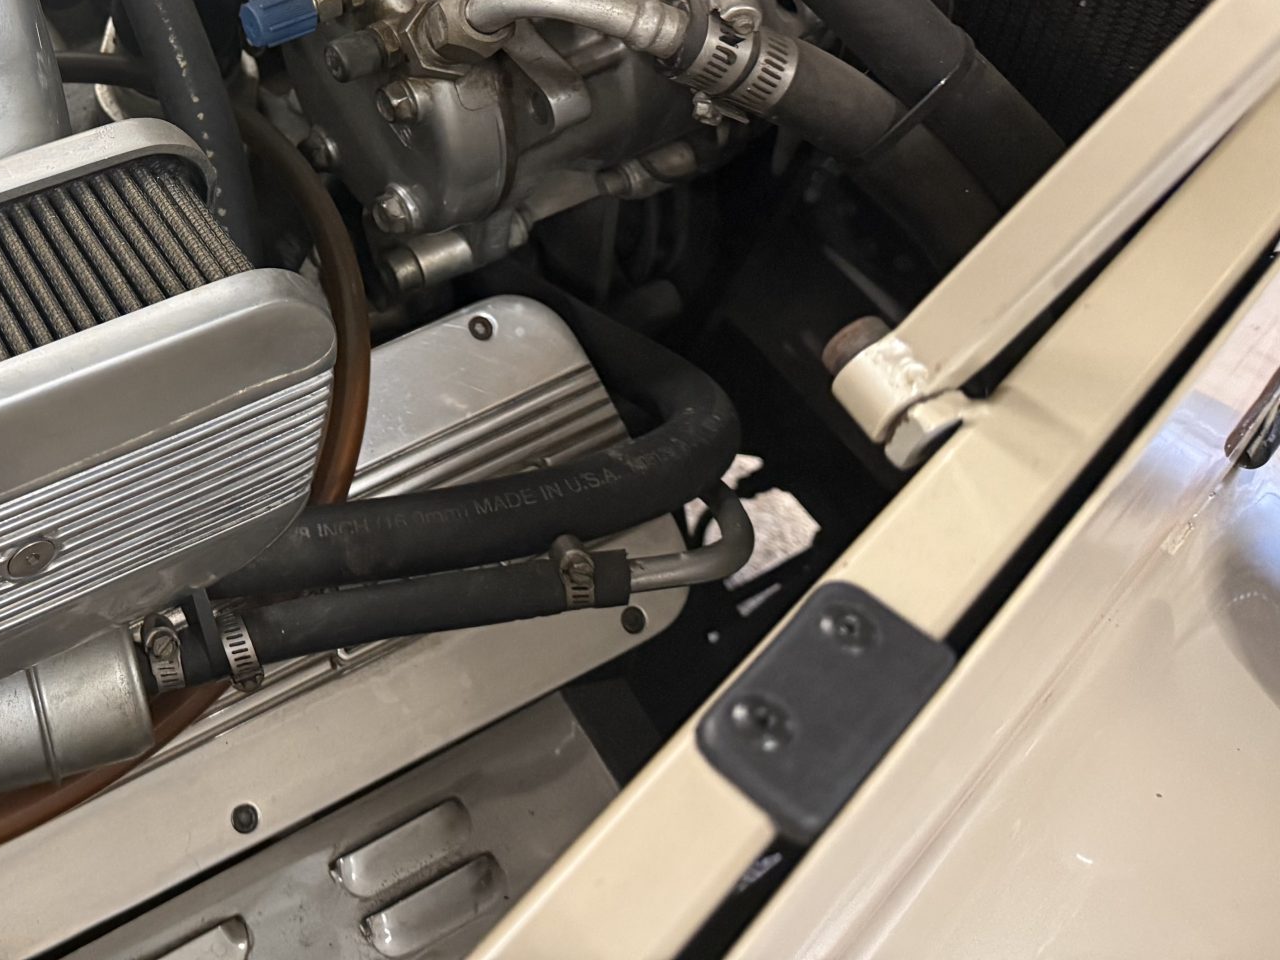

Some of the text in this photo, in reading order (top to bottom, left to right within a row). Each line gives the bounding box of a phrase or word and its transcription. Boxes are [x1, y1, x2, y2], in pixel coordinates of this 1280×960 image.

[317, 517, 369, 537] INCH
[474, 489, 537, 515] MADE
[540, 481, 564, 501] IN
[564, 467, 621, 493] U.S.A.
